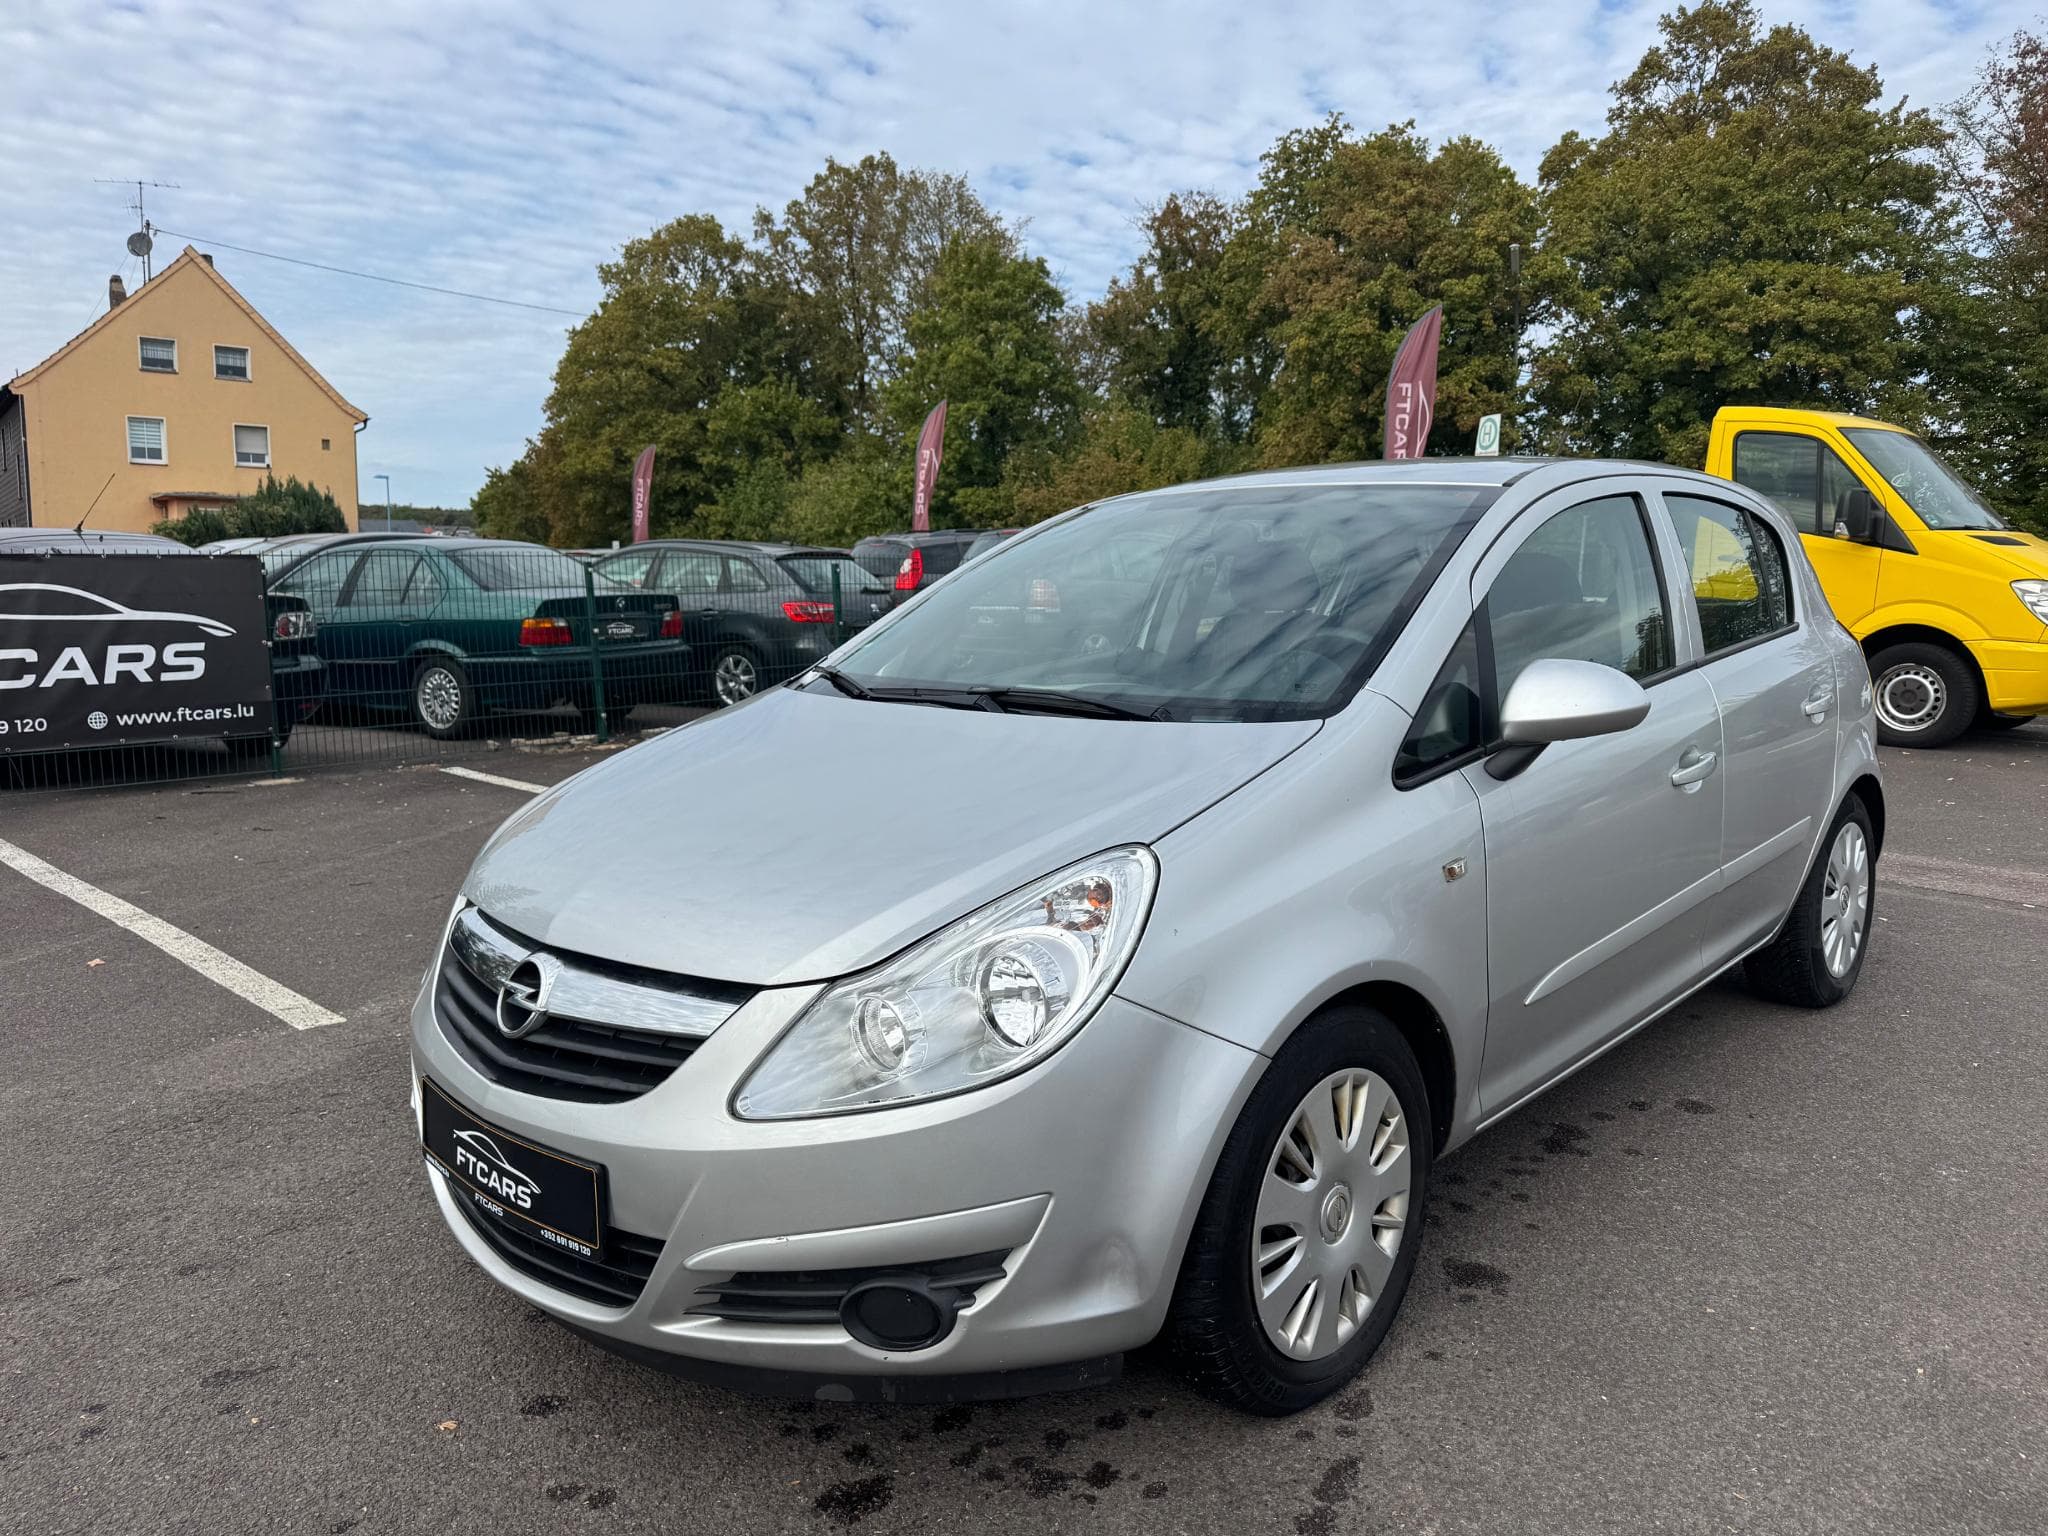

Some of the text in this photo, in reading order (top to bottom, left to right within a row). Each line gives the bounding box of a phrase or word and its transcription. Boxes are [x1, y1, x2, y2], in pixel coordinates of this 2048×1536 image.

[1482, 423, 1492, 443] H
[915, 449, 931, 514] FTCARS
[0, 642, 206, 690] CARS
[14, 718, 47, 733] 120
[116, 703, 255, 726] www.ftcars.lu
[457, 1145, 531, 1209] FTCARS
[475, 1192, 503, 1217] FTCARS
[580, 1244, 591, 1257] 120
